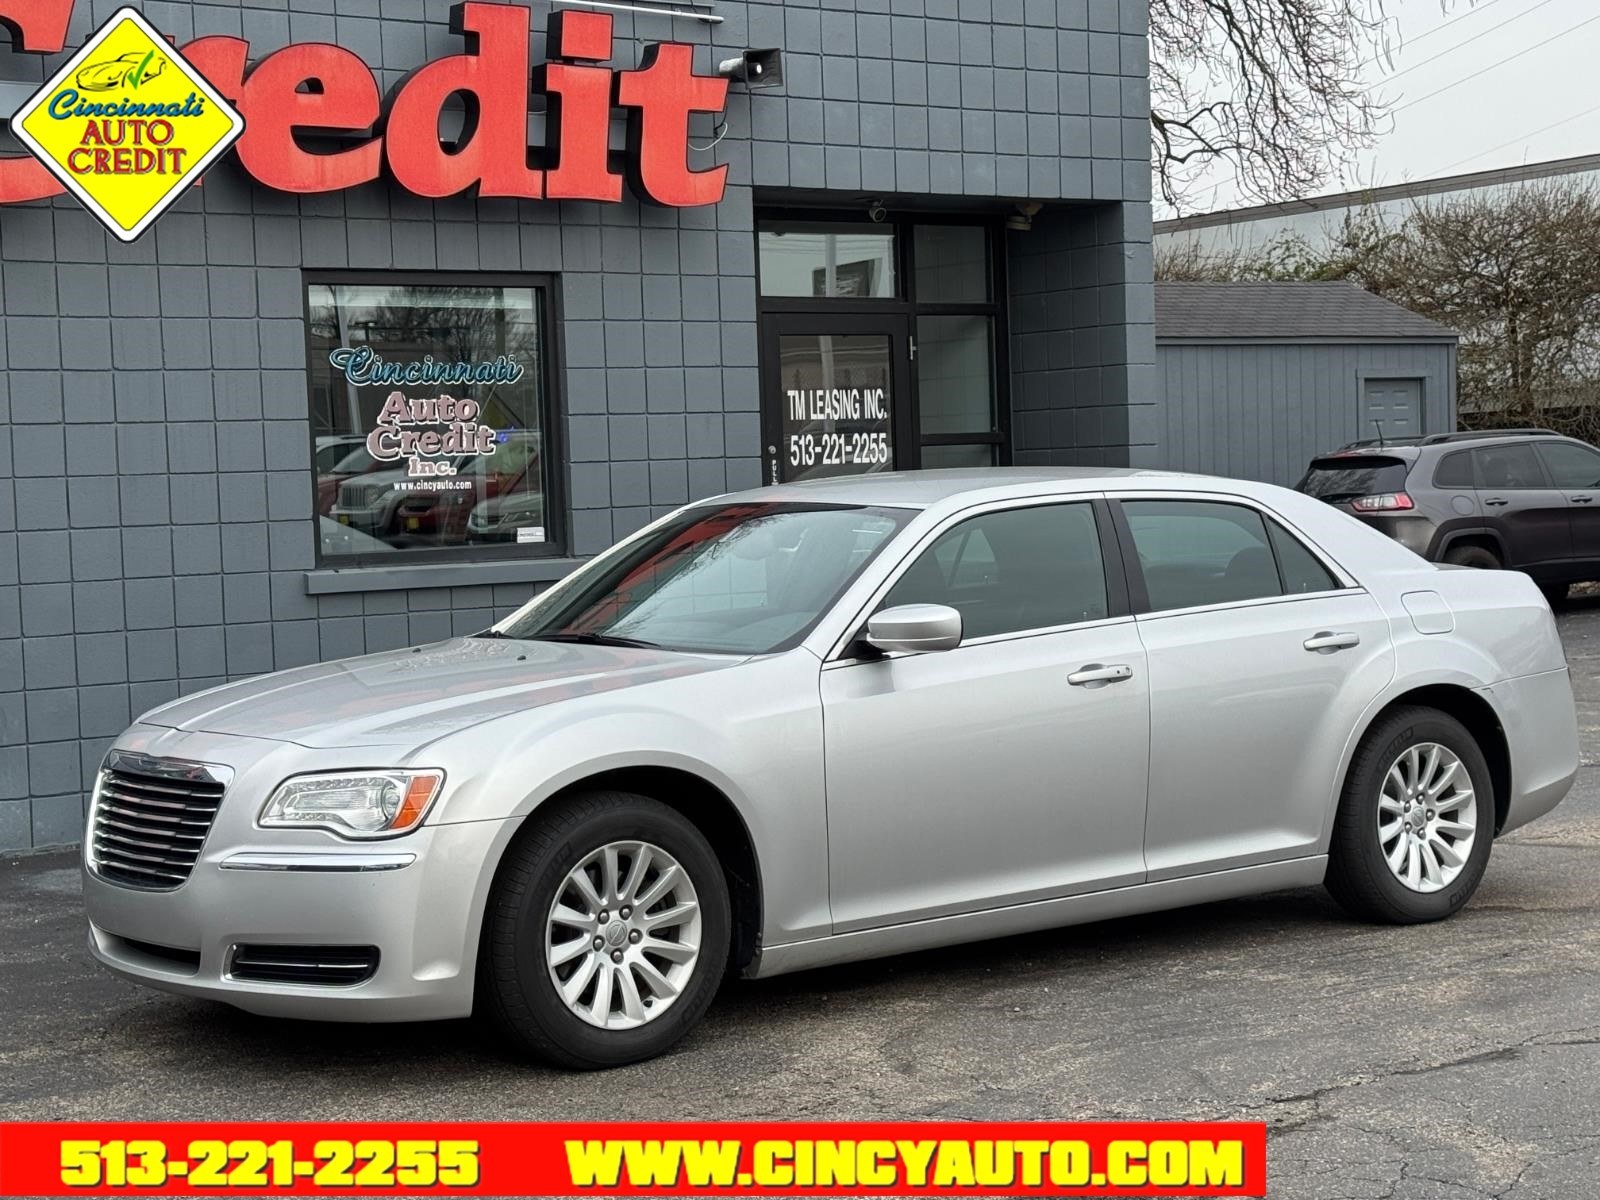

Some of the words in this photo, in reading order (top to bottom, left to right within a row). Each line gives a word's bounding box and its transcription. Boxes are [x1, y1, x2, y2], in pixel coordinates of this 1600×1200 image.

[329, 346, 524, 386] Cincinnati
[377, 391, 480, 426] Auto
[787, 390, 806, 421] TM
[809, 389, 860, 420] LEASING
[864, 388, 888, 420] INC.
[366, 423, 496, 461] Credit
[790, 433, 888, 466] 513-221-2255
[408, 458, 457, 477] Inc.
[393, 480, 472, 493] www.cincyauto.com
